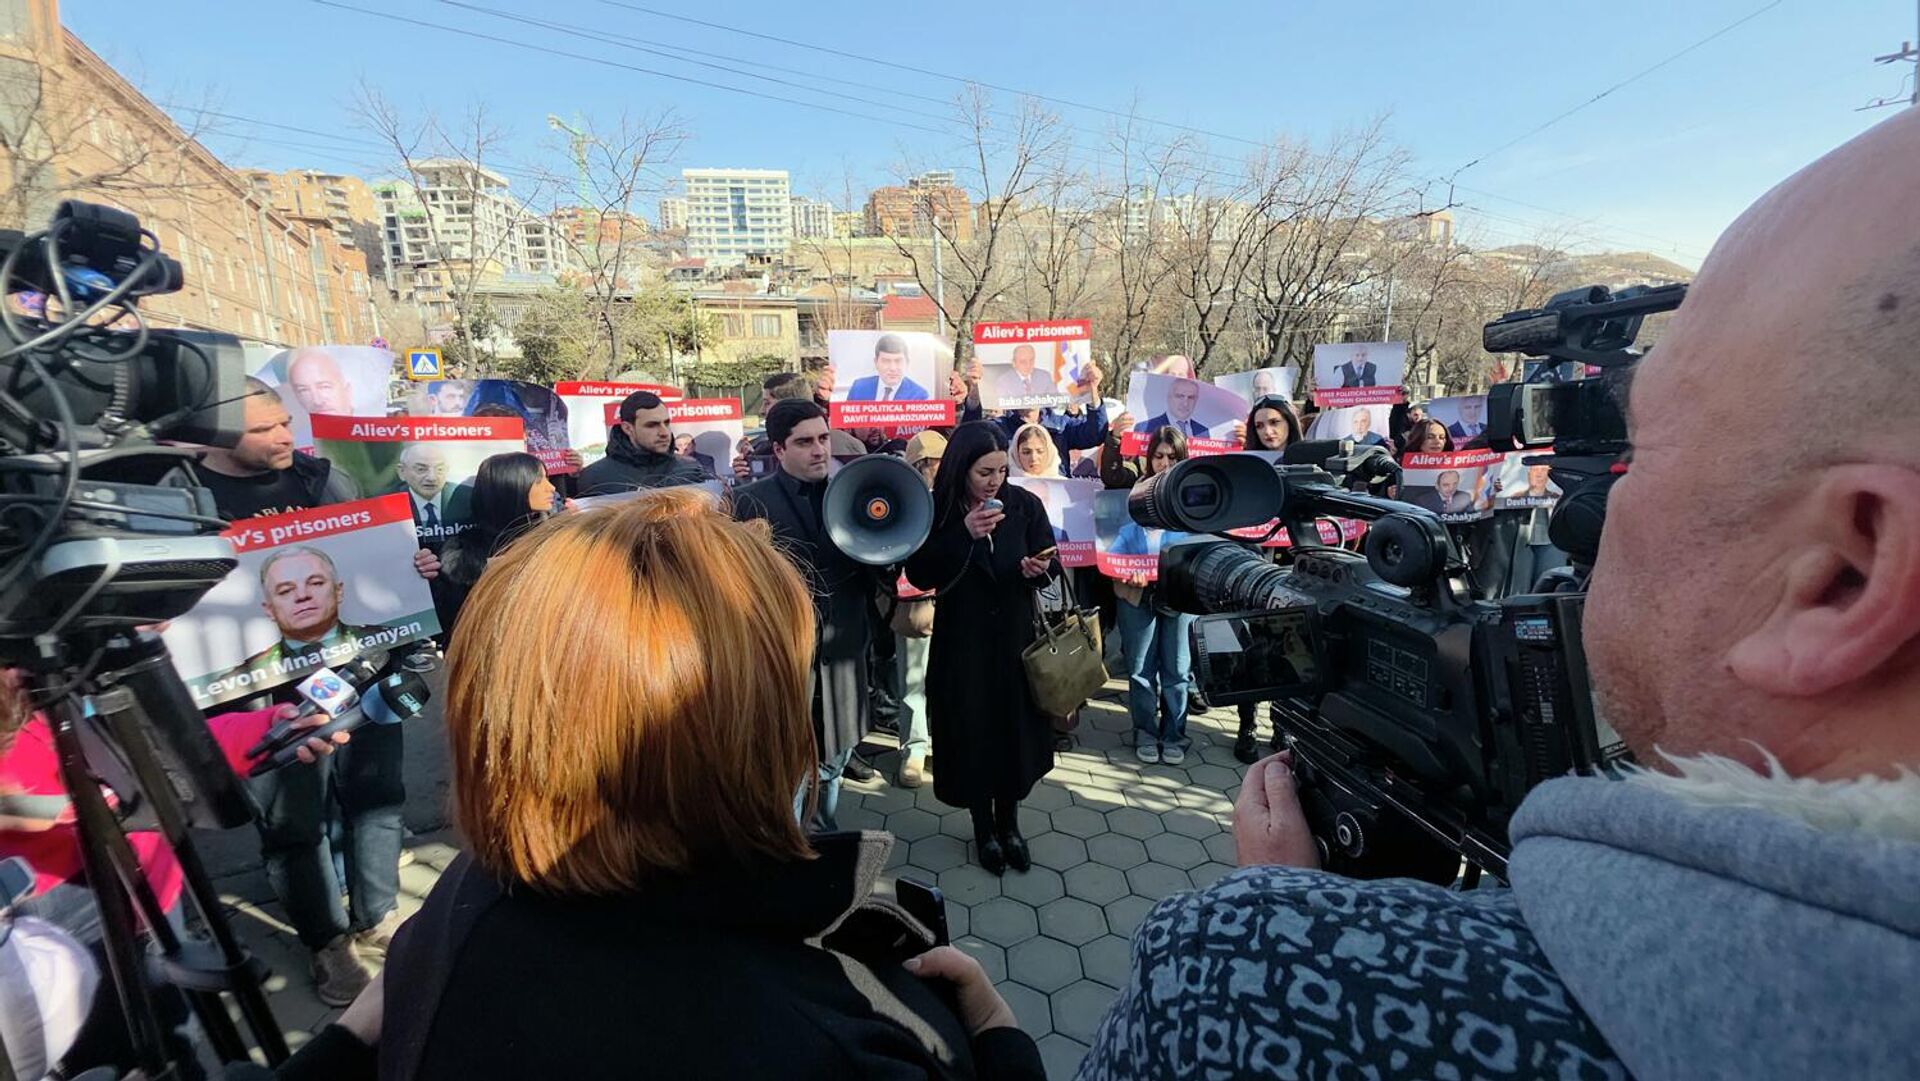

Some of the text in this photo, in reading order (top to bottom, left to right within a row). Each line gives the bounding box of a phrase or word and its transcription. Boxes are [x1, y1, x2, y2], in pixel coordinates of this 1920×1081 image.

[982, 324, 1084, 340] Aliev's prisoners
[578, 385, 663, 396] Aliev's prisrs
[1022, 394, 1070, 406] Sahakyan
[669, 403, 733, 418] prisoners
[840, 403, 946, 413] FREE POLITICAL PRISONER
[843, 413, 946, 423] DAVIT HAMBARDZUMYAN
[351, 423, 492, 440] Aliev's prisoners
[896, 425, 931, 436] Aliev'
[535, 450, 562, 460] ONER
[1410, 454, 1452, 465] Aliev's
[1527, 497, 1557, 507] Manuky
[270, 509, 372, 545] prisoners
[1057, 542, 1093, 551] RISONER
[1128, 558, 1158, 567] POLITI
[190, 620, 422, 701] Levon Mnatsakanyan
